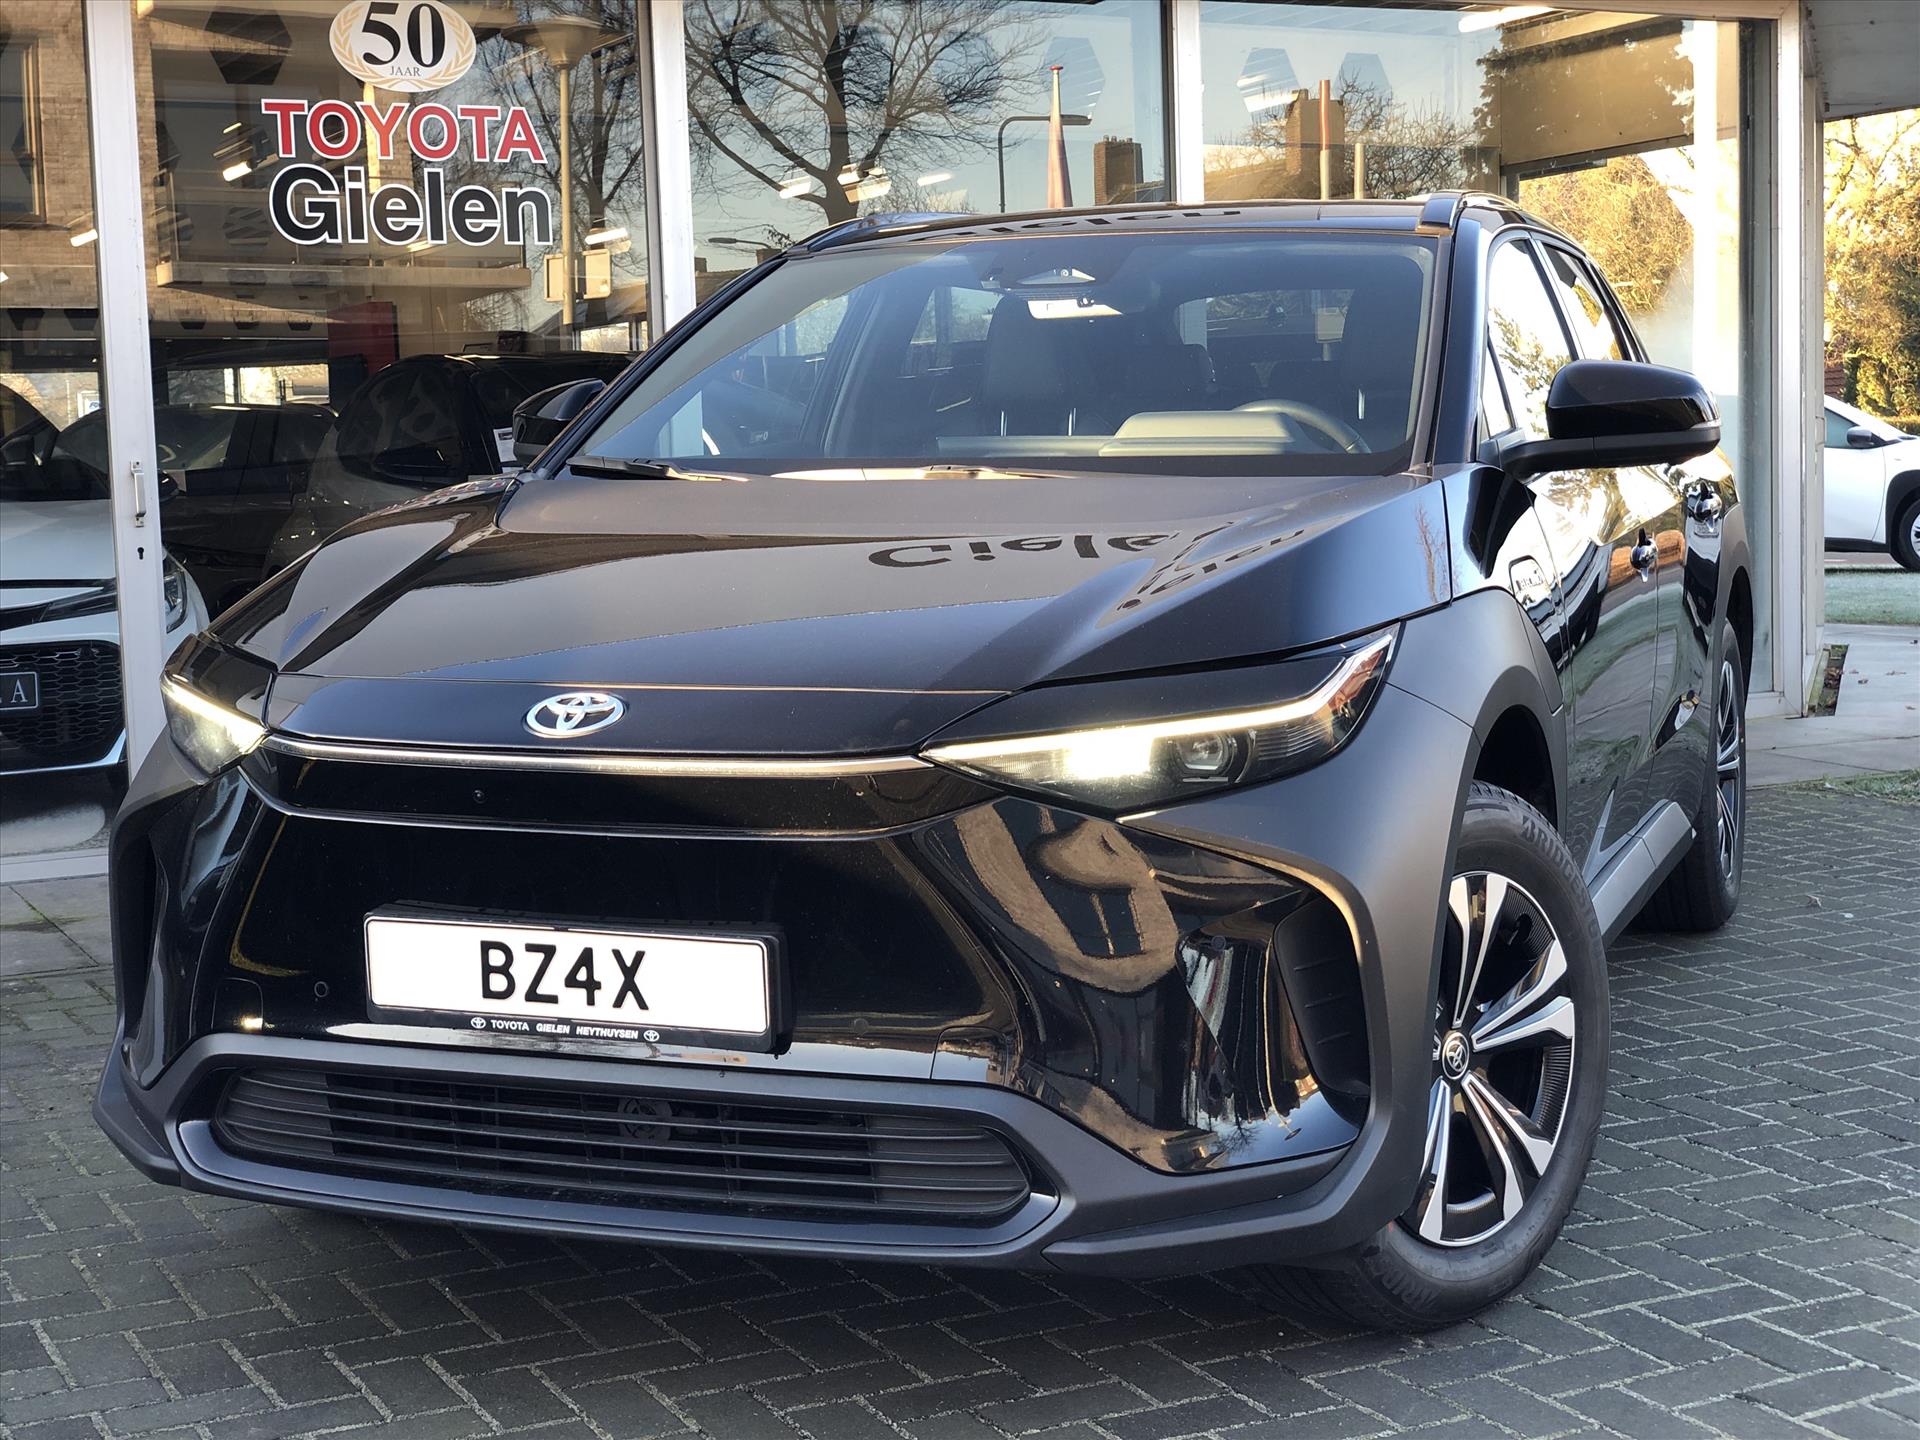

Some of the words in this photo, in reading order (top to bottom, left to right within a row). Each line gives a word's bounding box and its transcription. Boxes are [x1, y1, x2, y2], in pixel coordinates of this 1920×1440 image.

[362, 1, 445, 67] 50
[389, 65, 421, 77] JAAR
[261, 98, 548, 164] TOYOTA
[269, 163, 553, 246] Gielen
[480, 939, 649, 1011] BZ4X
[490, 1019, 530, 1031] TOYOTA
[536, 1023, 570, 1034] GIELEN
[576, 1026, 639, 1040] HEYTHUYSEN
